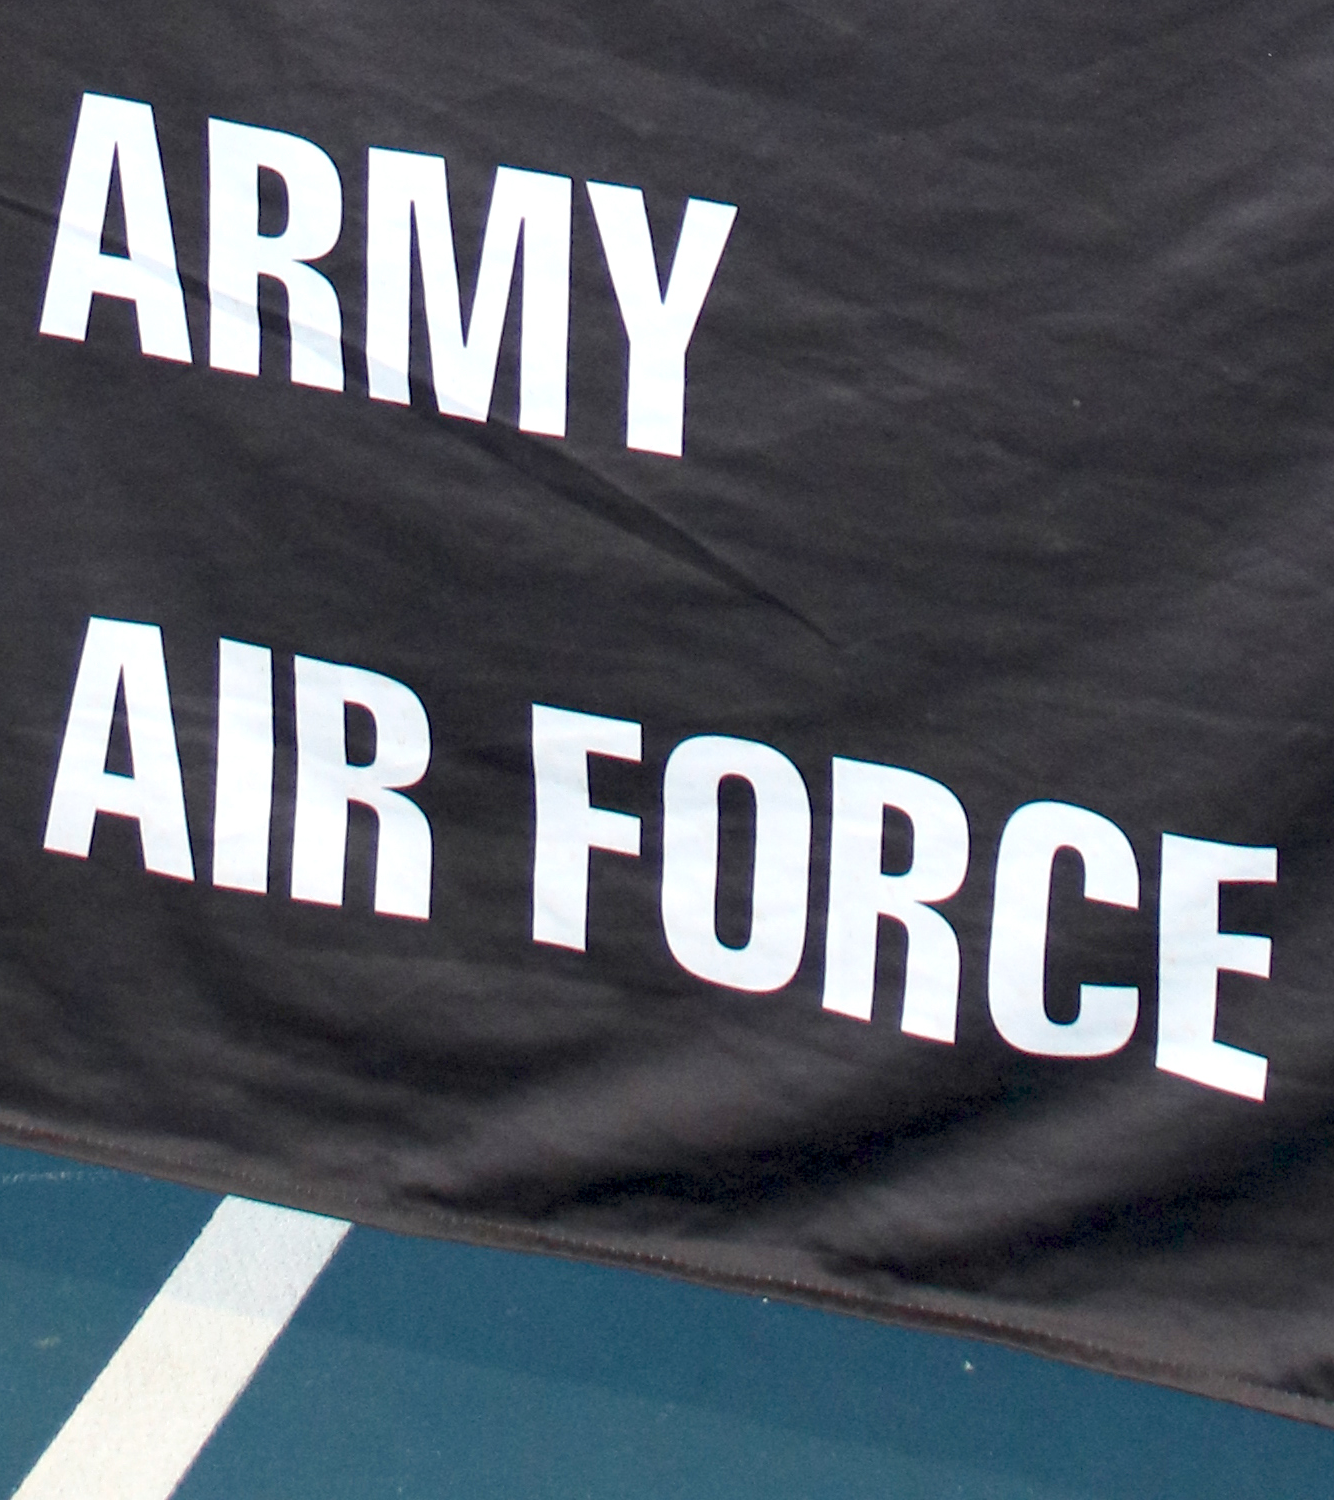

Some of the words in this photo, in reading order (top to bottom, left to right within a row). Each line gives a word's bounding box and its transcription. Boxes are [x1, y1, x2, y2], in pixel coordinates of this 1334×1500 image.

[38, 90, 739, 458] ARMY
[43, 616, 435, 922] AIR
[531, 703, 1279, 1102] FORCE
